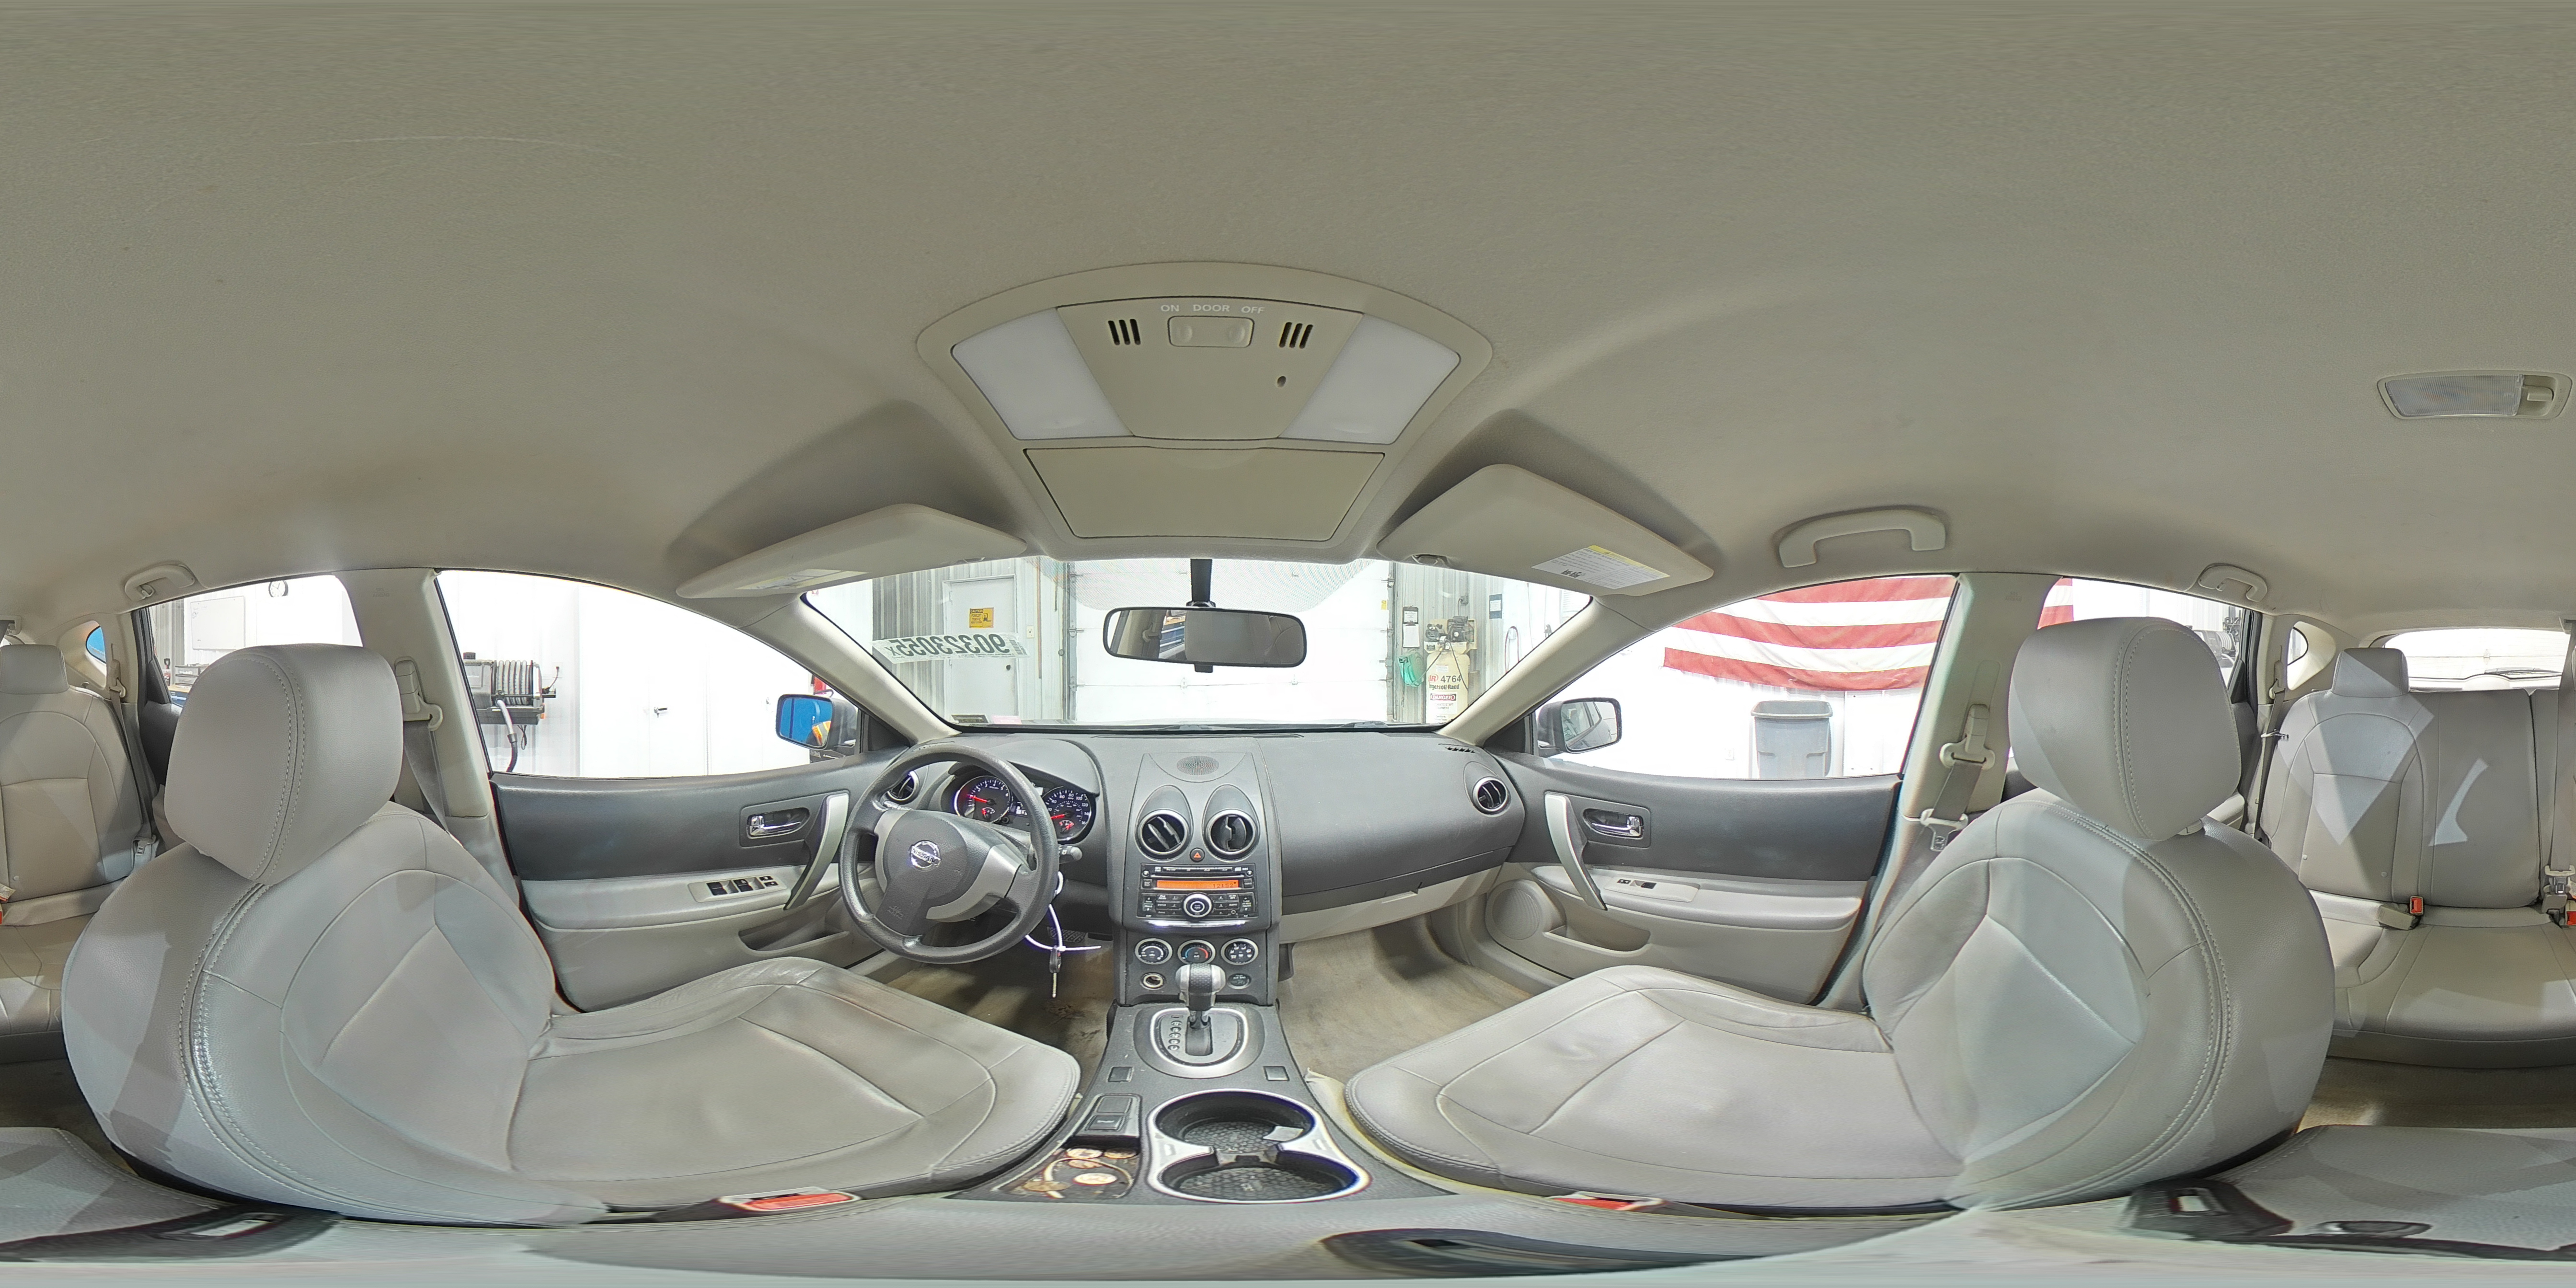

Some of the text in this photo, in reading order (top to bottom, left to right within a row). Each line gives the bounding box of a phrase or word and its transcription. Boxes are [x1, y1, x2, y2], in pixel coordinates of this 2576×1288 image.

[1193, 304, 1230, 312] DOOR
[1241, 306, 1265, 314] OFF
[1440, 675, 1461, 683] 4764
